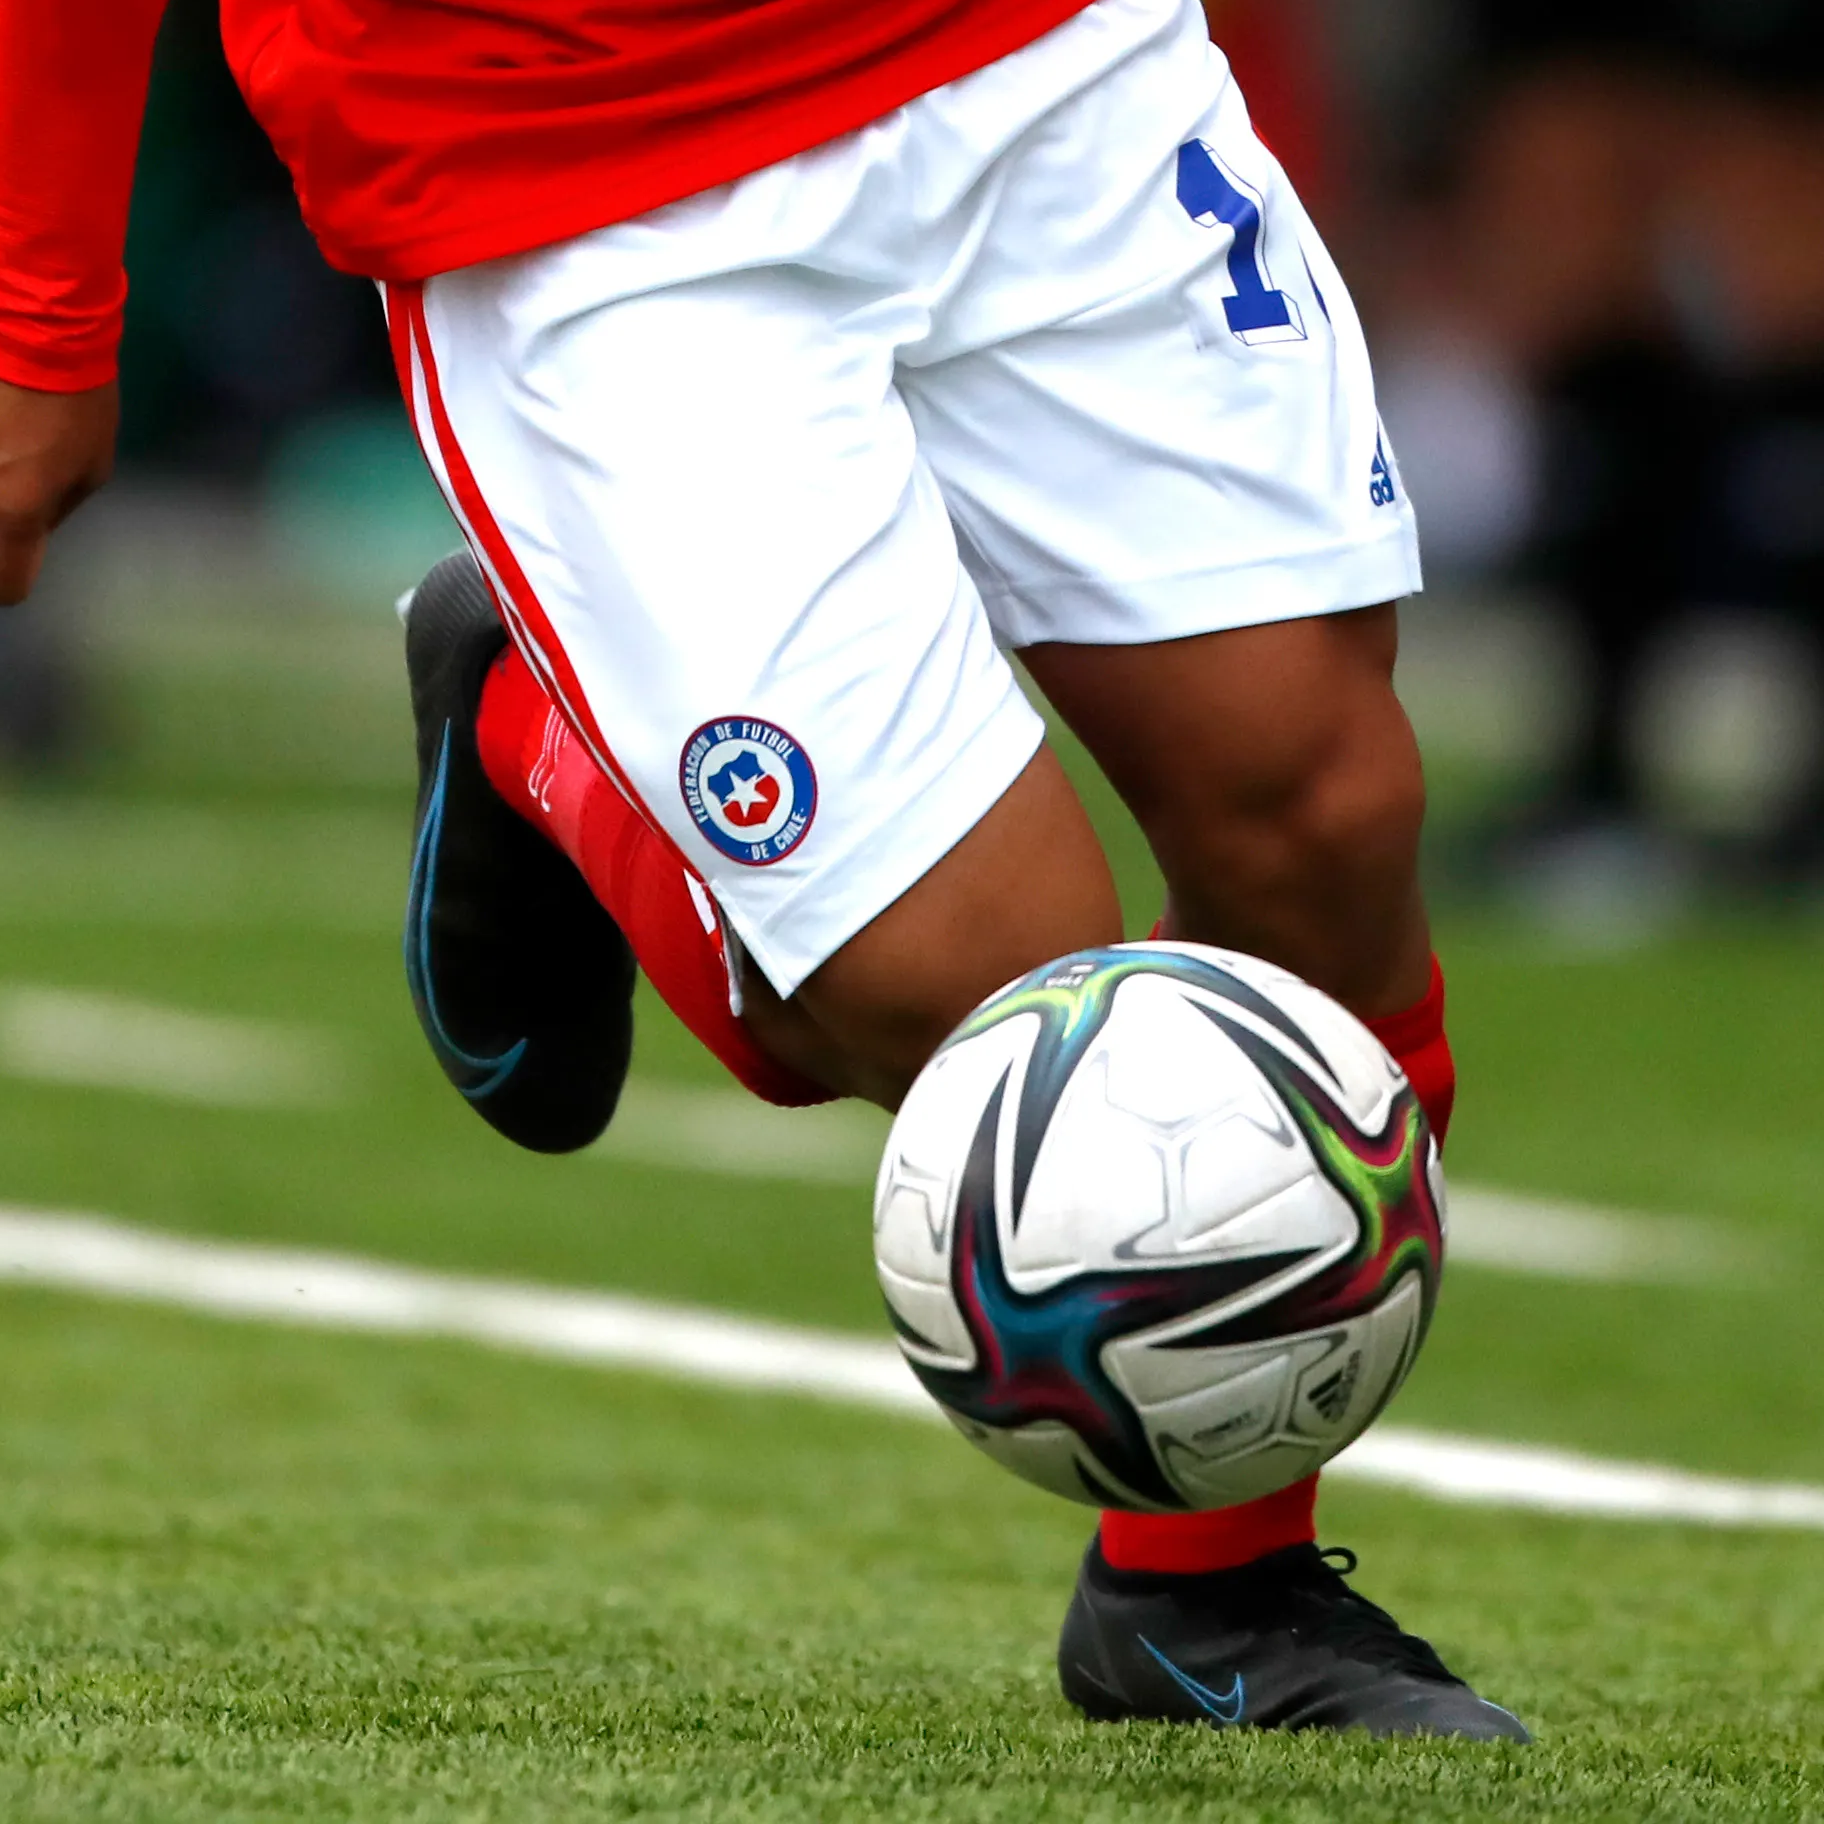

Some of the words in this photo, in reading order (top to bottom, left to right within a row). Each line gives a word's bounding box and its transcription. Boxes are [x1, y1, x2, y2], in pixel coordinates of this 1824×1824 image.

[1176, 137, 1332, 346] 1
[685, 734, 711, 824] FEDERACION
[714, 723, 734, 740] DE
[742, 723, 795, 761] FUTBOL
[751, 843, 769, 861] DE
[774, 810, 807, 851] CHILE
